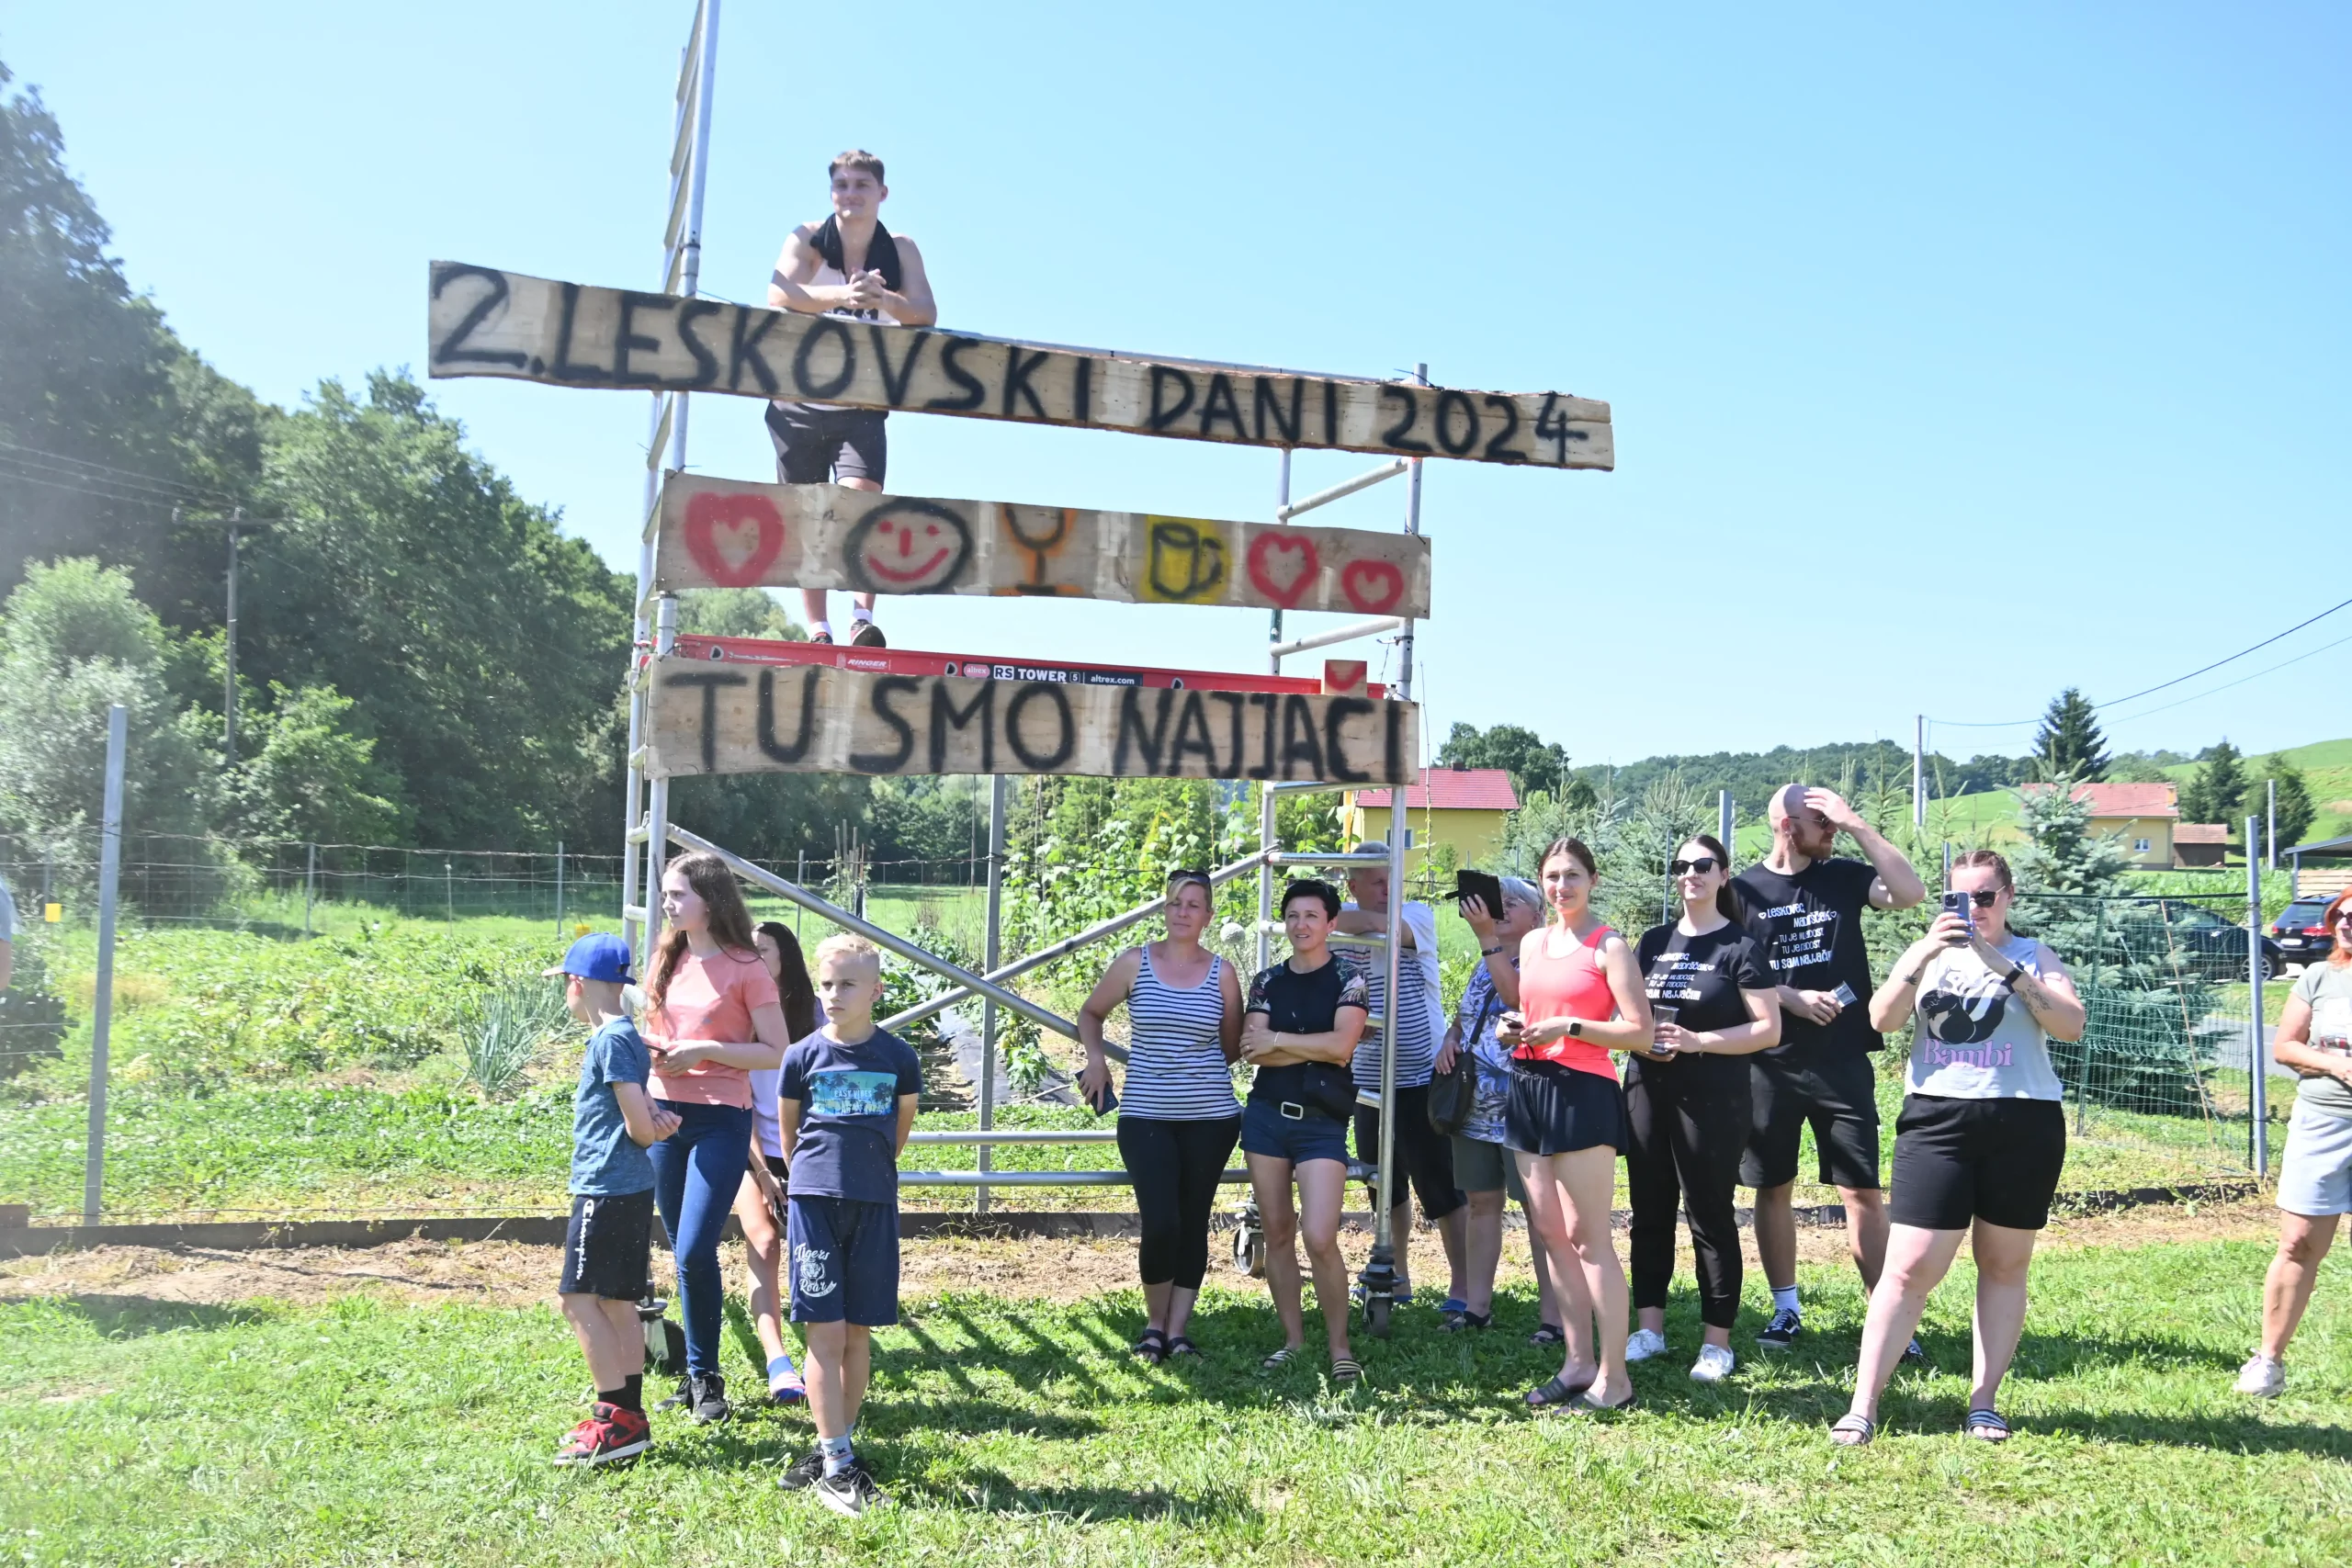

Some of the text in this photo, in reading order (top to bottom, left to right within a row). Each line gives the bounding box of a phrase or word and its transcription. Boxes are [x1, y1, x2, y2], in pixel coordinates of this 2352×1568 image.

[553, 281, 1094, 424] LESKOVSKI
[1148, 366, 1339, 446] DANI
[1381, 383, 1590, 467] 2024
[847, 659, 888, 667] RINGER
[967, 664, 987, 674] altrex
[994, 667, 1013, 680] RS
[1018, 668, 1067, 682] TOWER
[1091, 674, 1136, 685] altrex.com
[662, 663, 820, 773] TU
[848, 675, 1076, 773] SMO
[1779, 934, 1787, 943] TU
[1781, 945, 1790, 954] TU
[1769, 960, 1780, 970] TU
[1923, 1037, 2015, 1073] Bambi
[834, 1089, 851, 1098] EASY
[574, 1199, 594, 1280] Champion
[795, 1242, 831, 1262] Tigers
[799, 1278, 827, 1292] Roar
